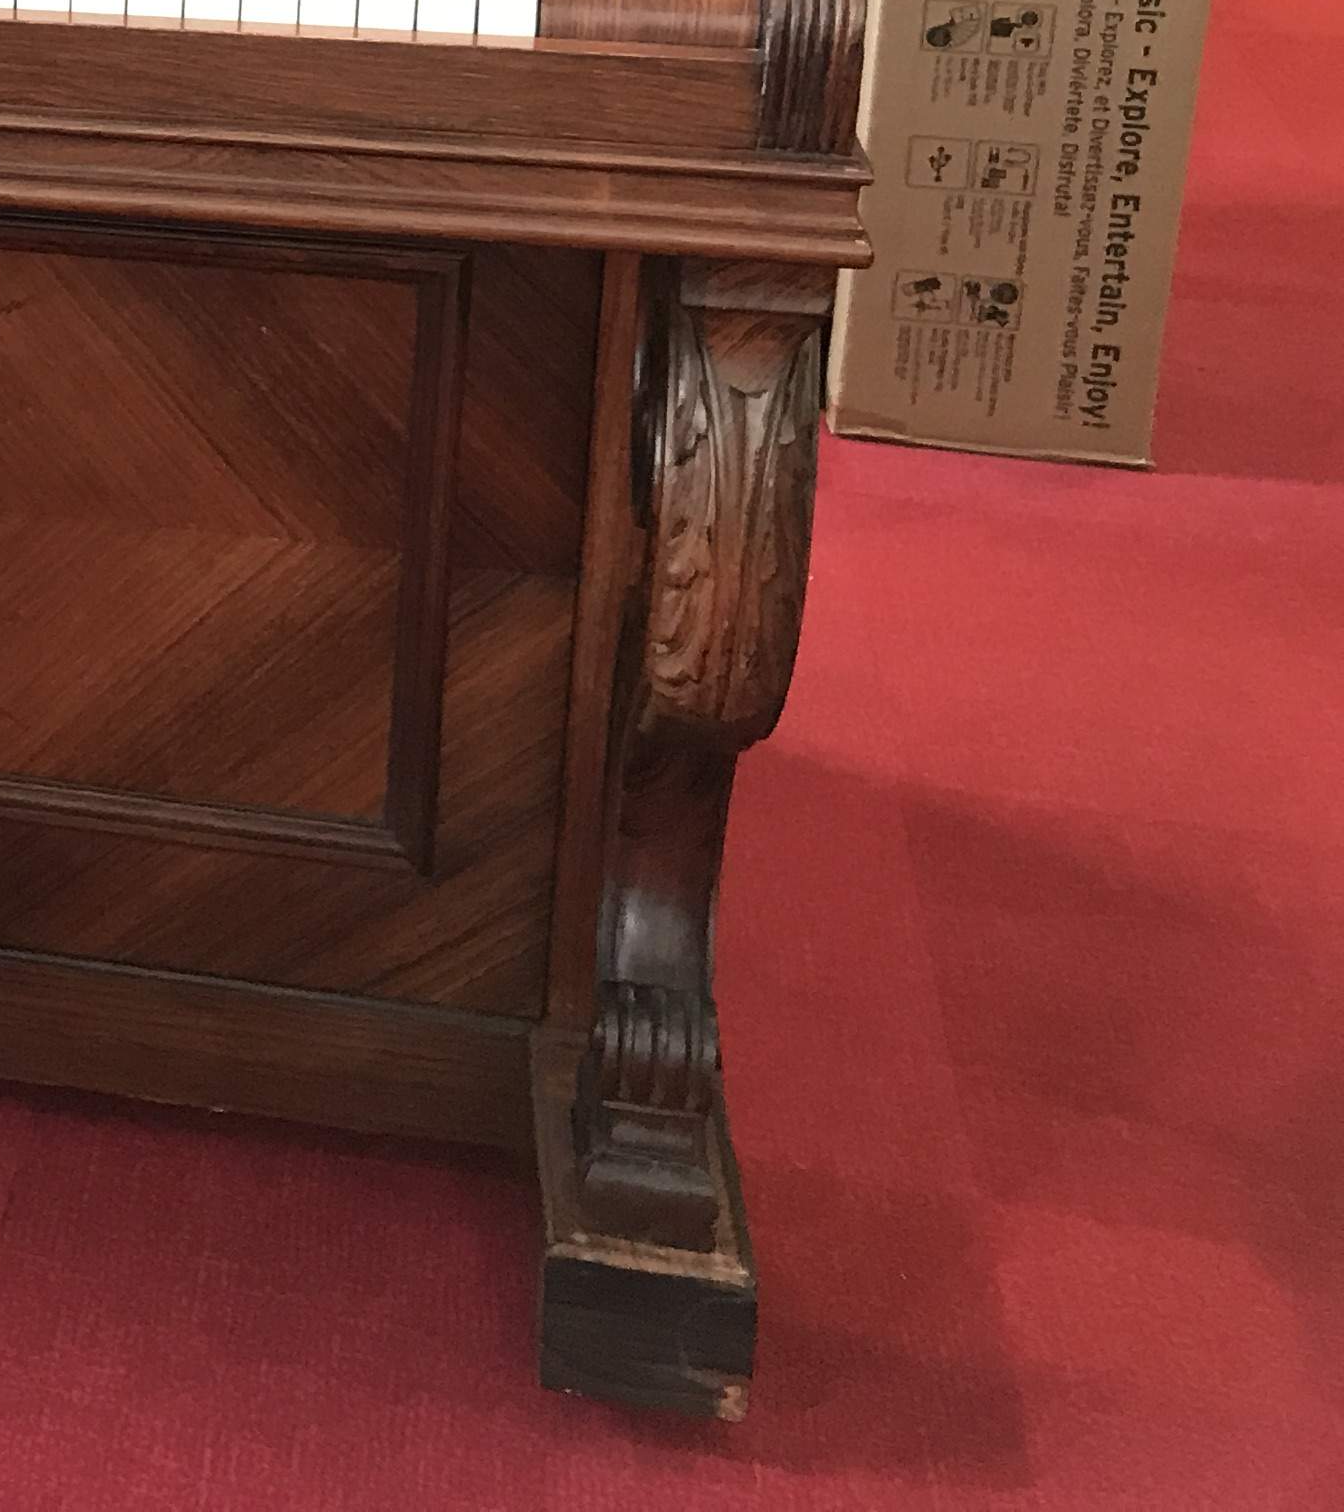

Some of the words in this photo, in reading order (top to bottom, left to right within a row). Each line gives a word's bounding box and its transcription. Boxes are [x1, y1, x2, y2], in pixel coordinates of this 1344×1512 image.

[1094, 12, 1124, 90] Explorez,
[1092, 95, 1111, 113] et
[1110, 68, 1158, 182] Explore,
[1090, 194, 1141, 333] Entertain,
[1078, 343, 1121, 429] Enjoy!
